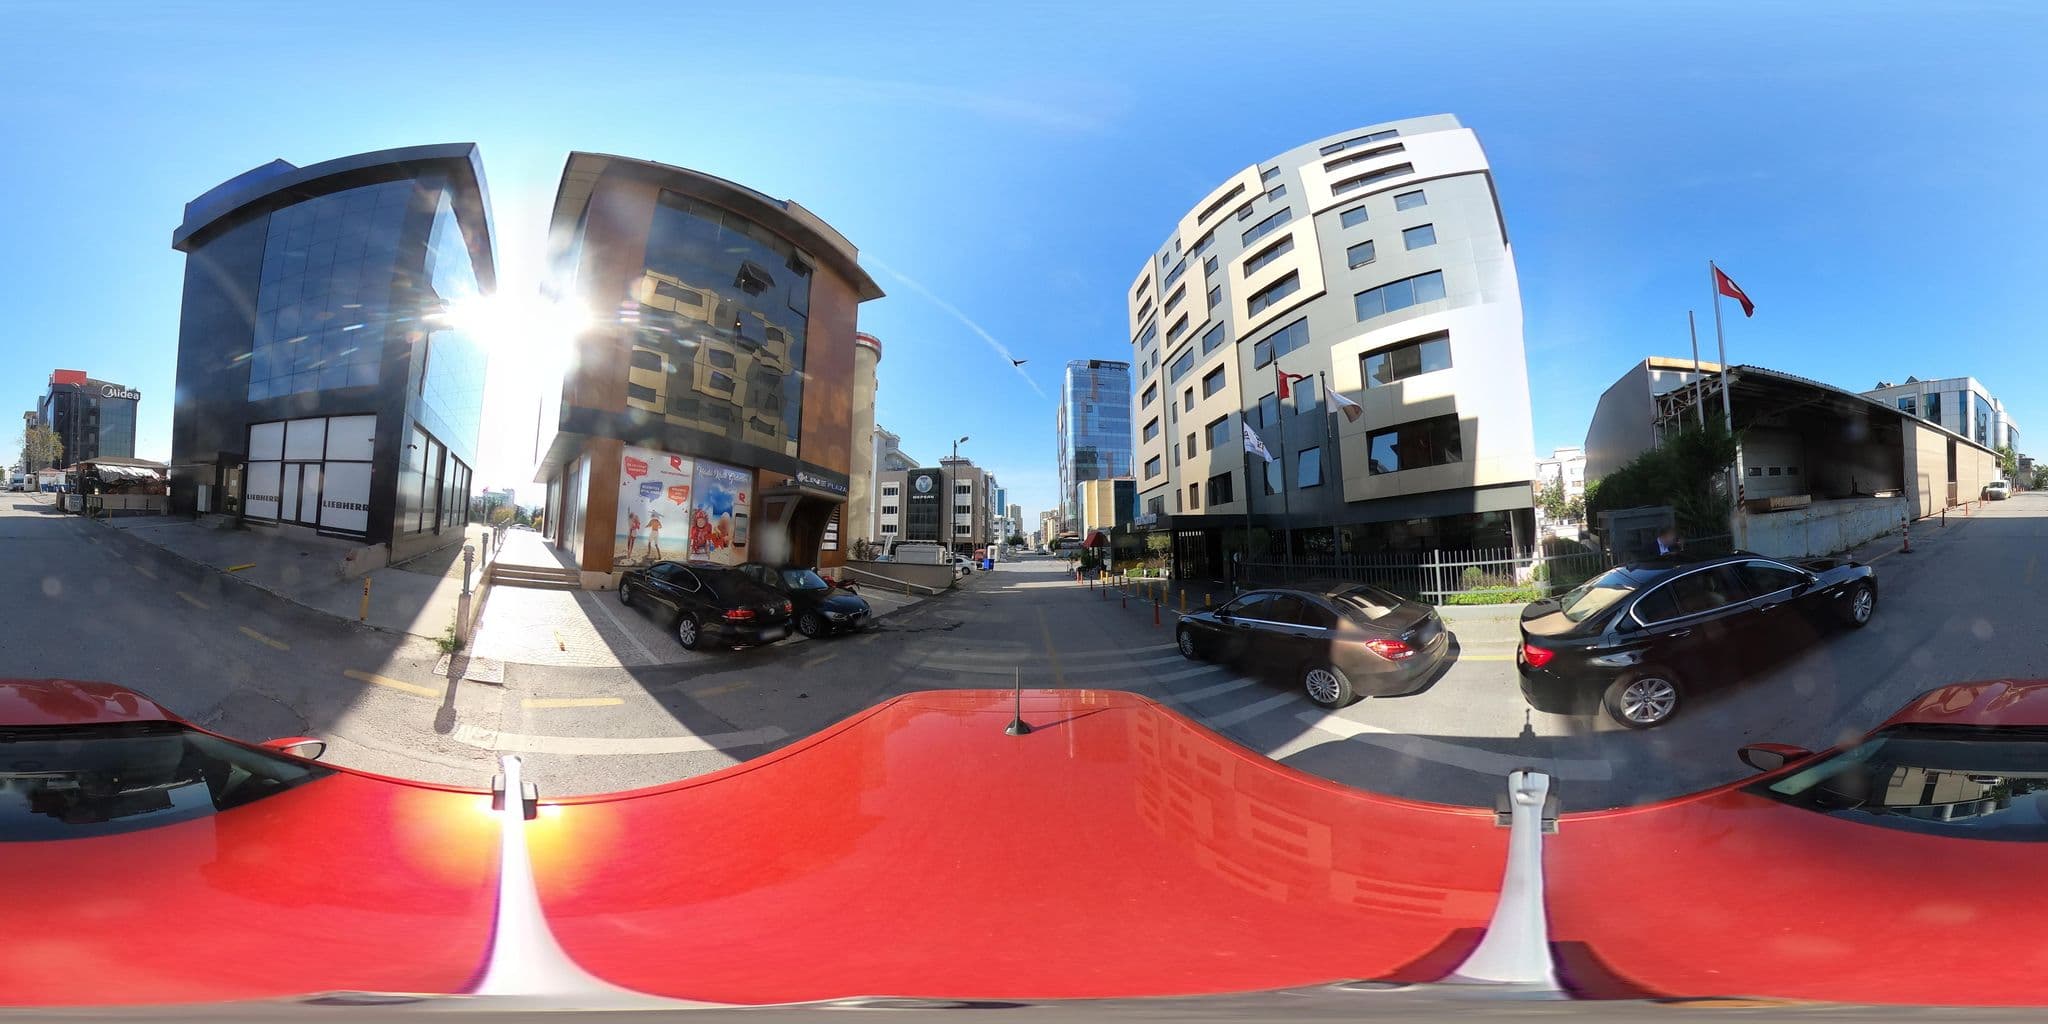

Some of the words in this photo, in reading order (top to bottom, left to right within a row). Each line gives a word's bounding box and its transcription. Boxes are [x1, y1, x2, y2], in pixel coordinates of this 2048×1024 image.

[101, 384, 140, 400] Midea
[247, 493, 280, 503] LIEBHERR
[323, 500, 369, 512] LIEBHERR
